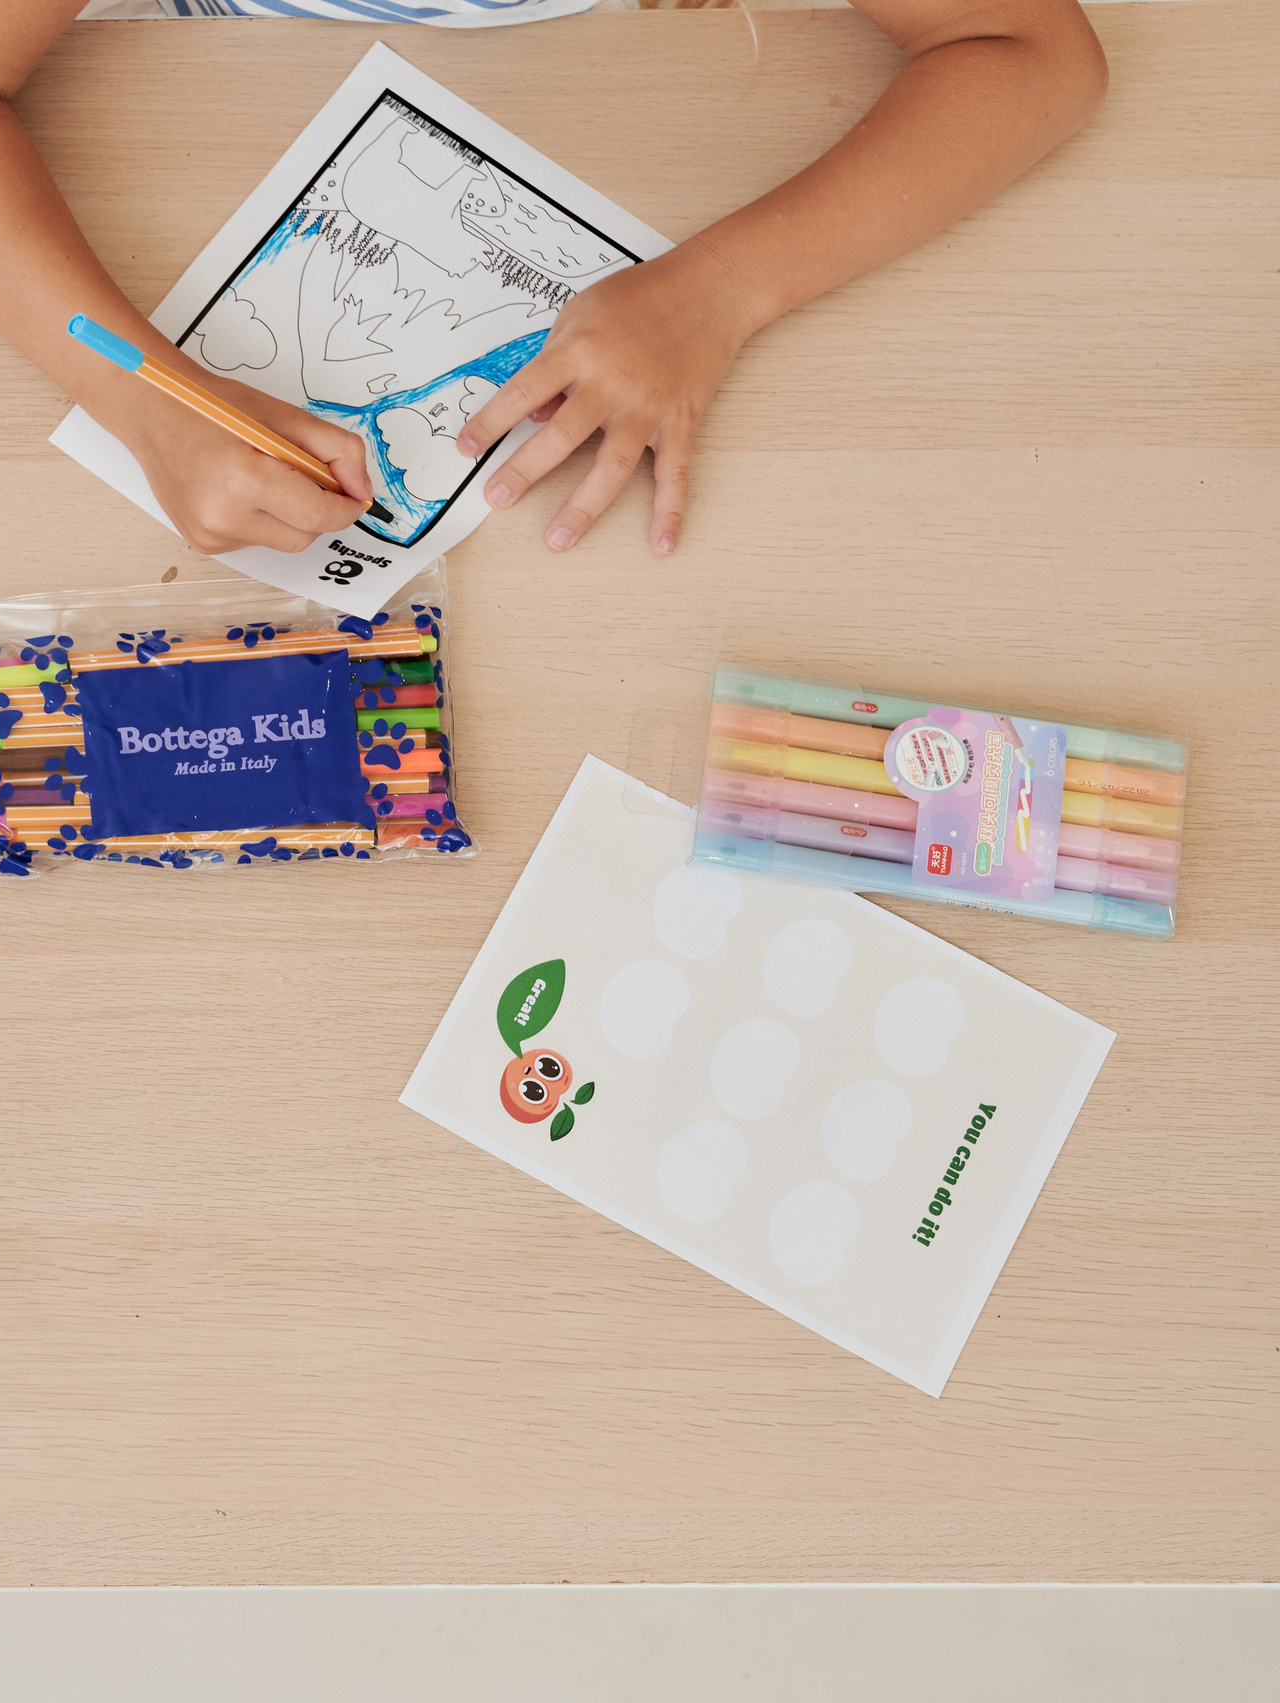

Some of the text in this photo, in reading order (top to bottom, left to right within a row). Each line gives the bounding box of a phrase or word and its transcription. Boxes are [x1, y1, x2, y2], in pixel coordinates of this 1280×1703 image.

[328, 539, 393, 568] Speechy
[117, 708, 327, 759] Bottega Kids
[174, 755, 278, 776] Made in Italy
[1048, 737, 1058, 768] COLORS
[931, 850, 941, 868] 天好
[940, 846, 949, 874] TIANHAO
[513, 978, 547, 1027] Great!
[912, 1103, 997, 1247] You can do it!
